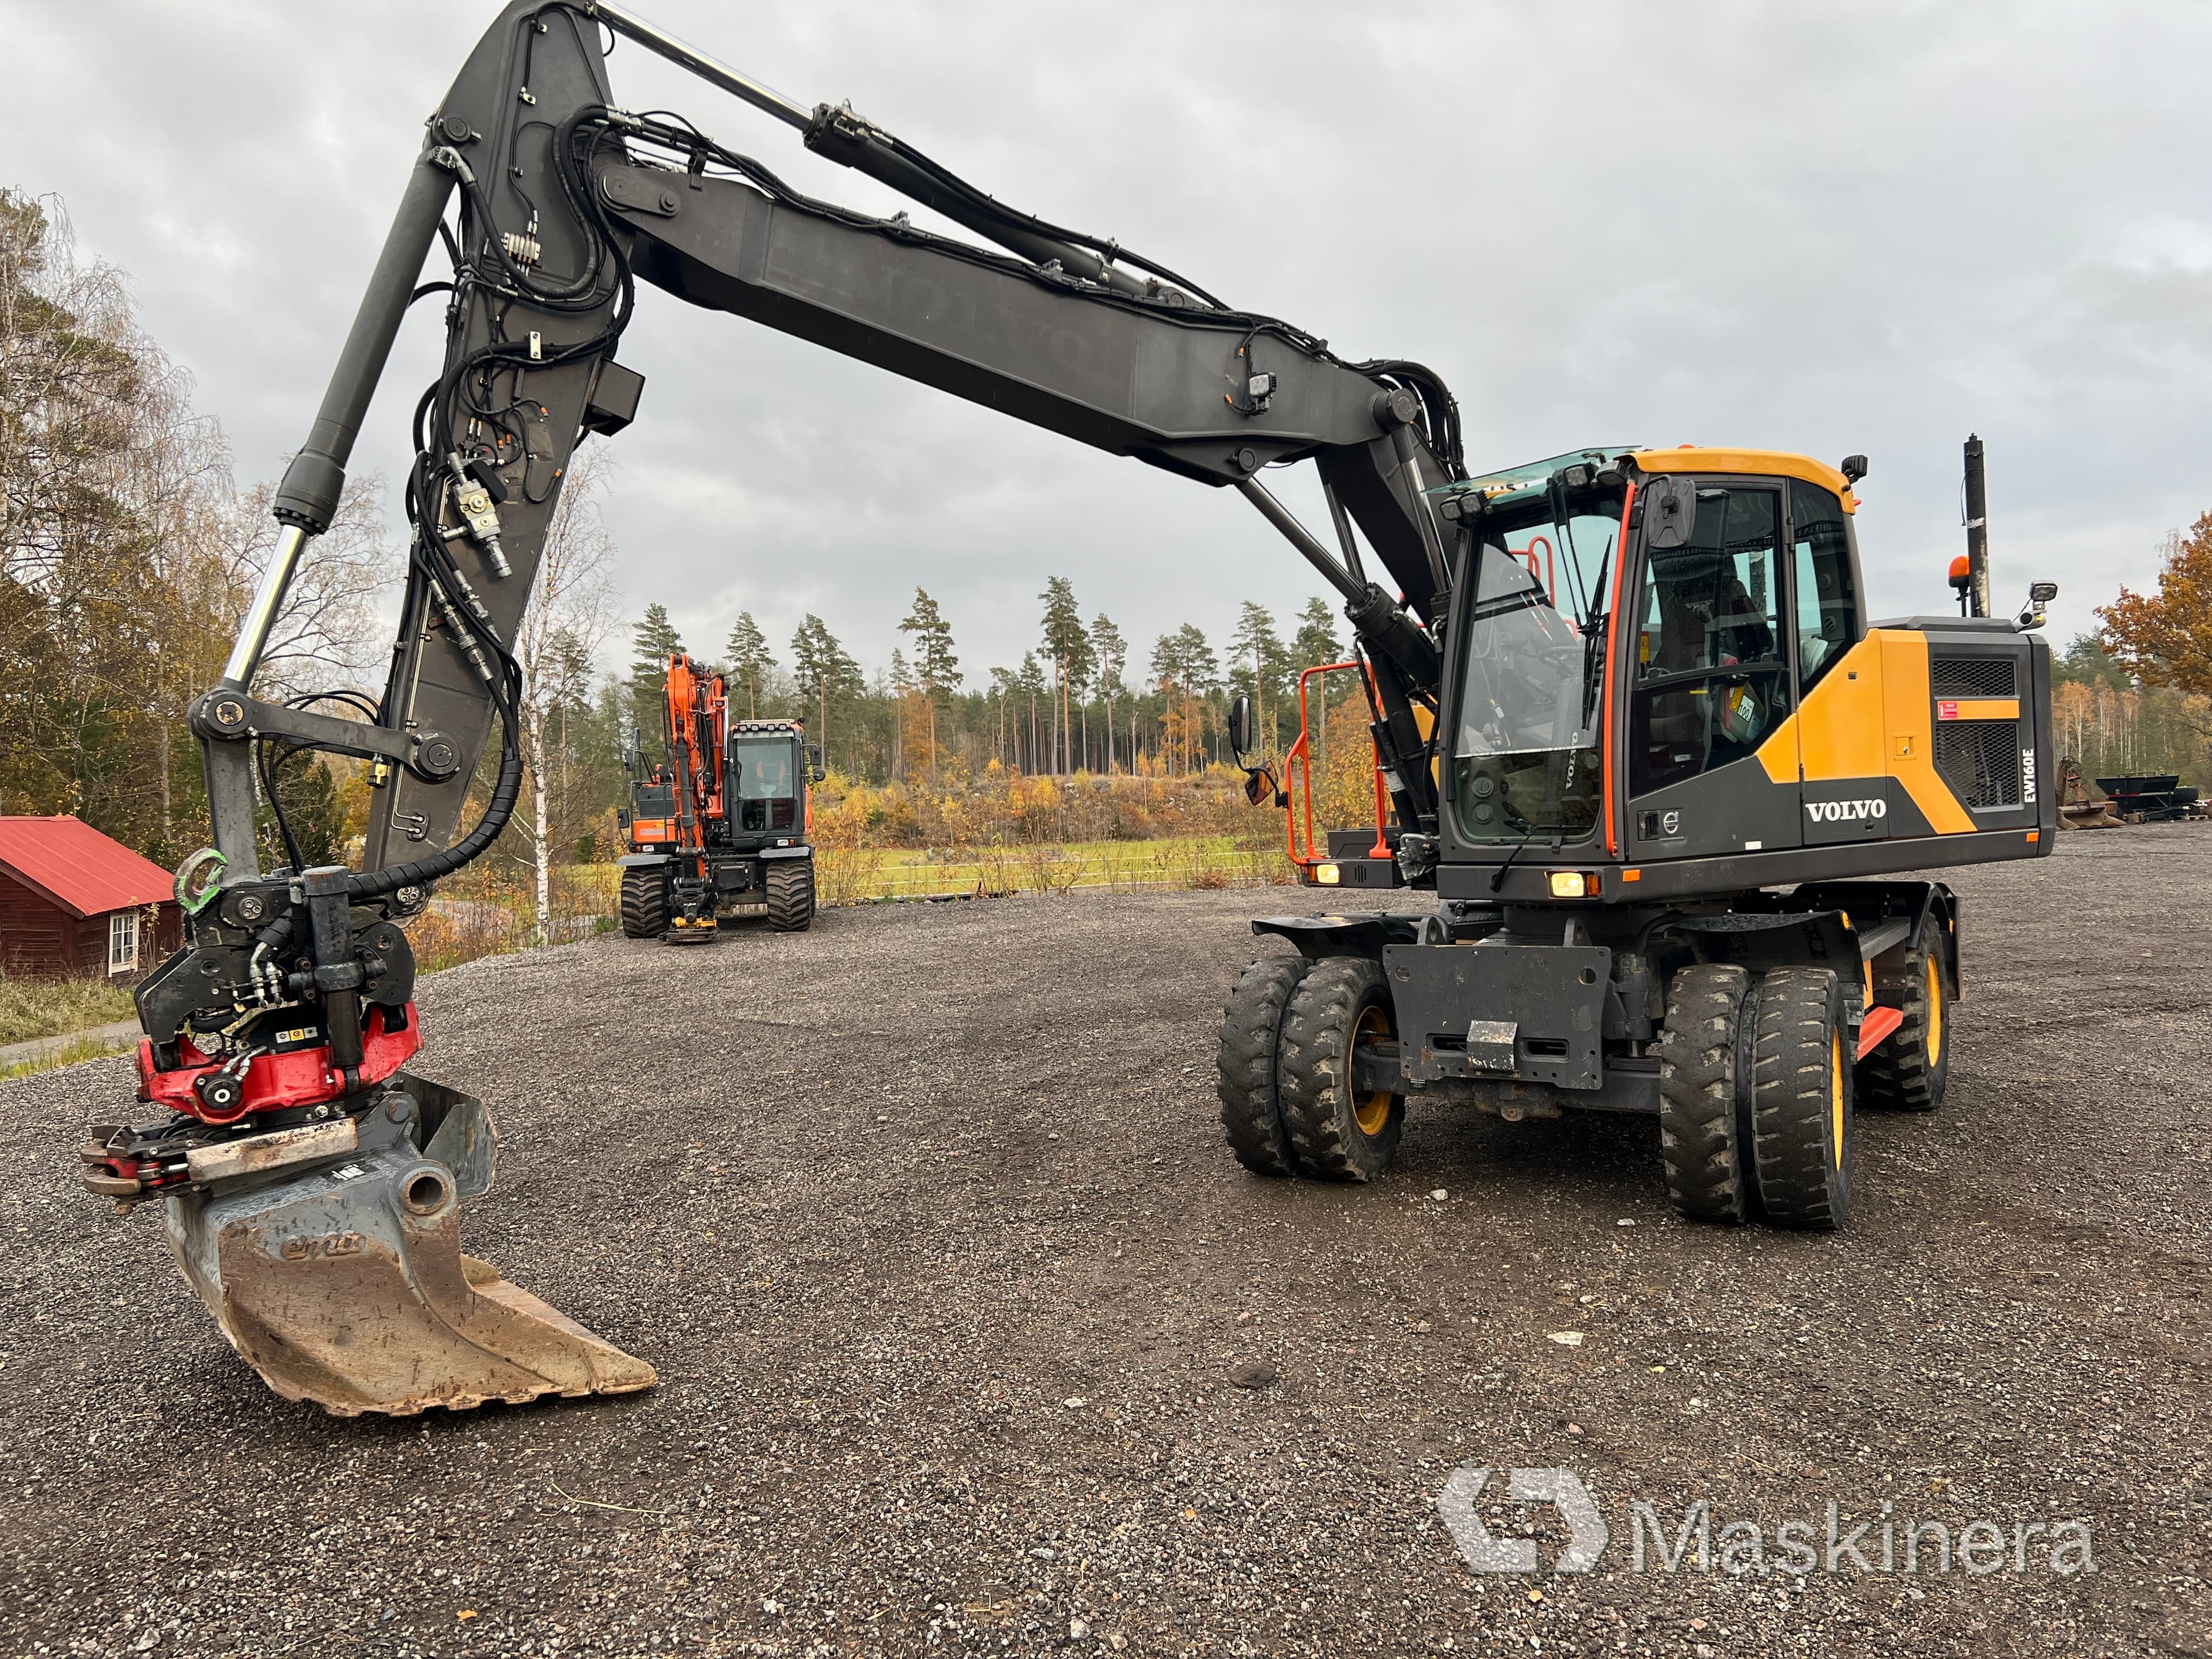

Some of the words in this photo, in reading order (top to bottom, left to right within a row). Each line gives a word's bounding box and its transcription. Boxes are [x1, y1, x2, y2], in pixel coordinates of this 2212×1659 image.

[1739, 705, 1749, 718] 100
[2022, 748, 2036, 803] EW160E
[1805, 798, 1887, 822] VOLVO
